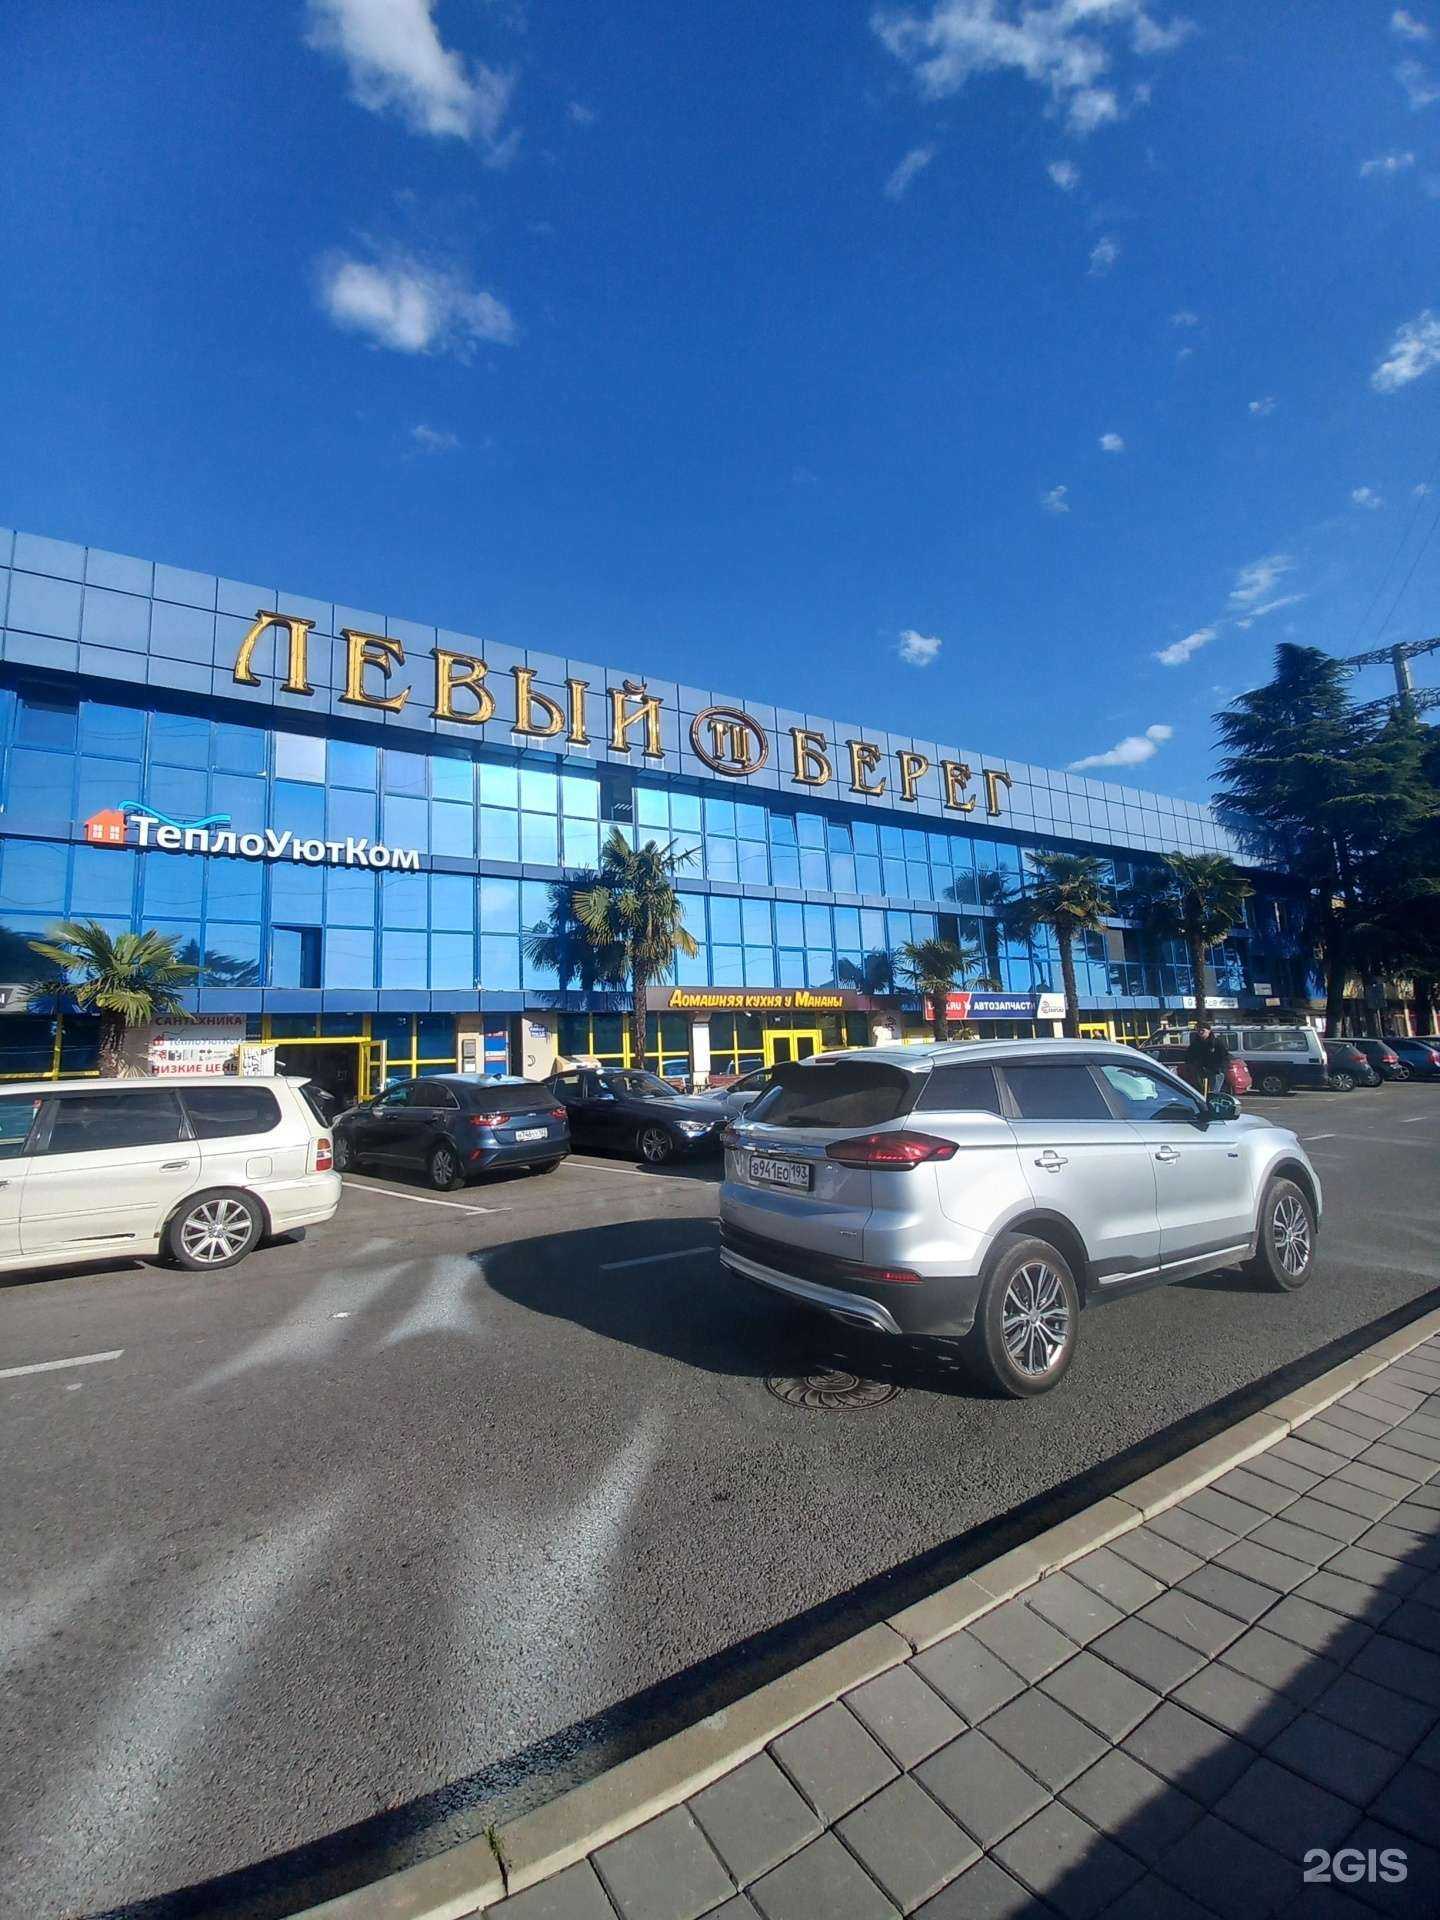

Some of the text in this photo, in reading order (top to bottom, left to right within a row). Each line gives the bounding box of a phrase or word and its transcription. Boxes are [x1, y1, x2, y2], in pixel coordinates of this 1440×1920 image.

[233, 609, 665, 759] ЛЕВЫЙ
[789, 727, 1012, 816] БЕРЕГ
[130, 815, 420, 870] ТеплоУютКом
[670, 990, 843, 1008] Домашняя кухня у Мананы
[974, 1001, 1035, 1011] АВТОЗАПЧАСТИ
[155, 1015, 242, 1025] САНТЕХНИКА
[151, 1063, 202, 1074] НИЗКИЕ
